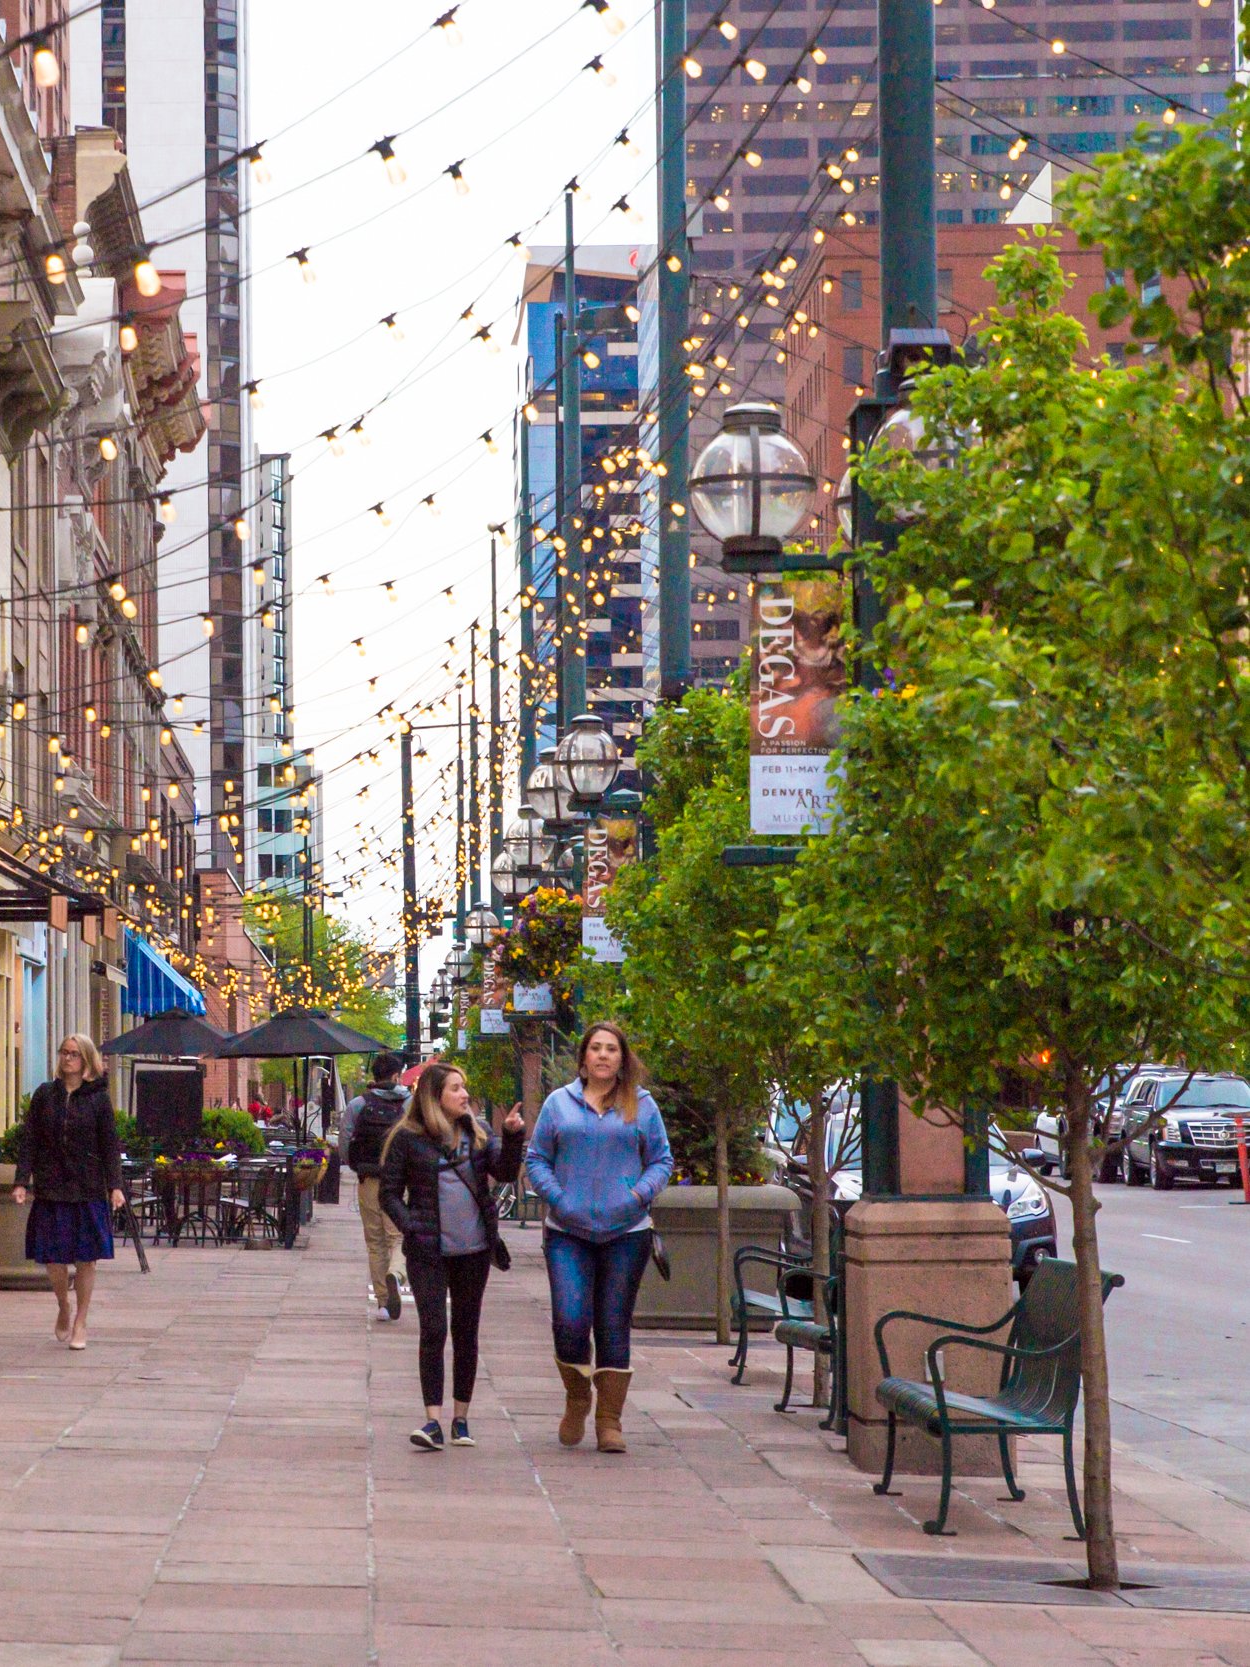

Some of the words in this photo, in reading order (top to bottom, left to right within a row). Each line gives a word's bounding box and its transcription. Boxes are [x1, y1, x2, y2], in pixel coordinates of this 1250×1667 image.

[758, 596, 795, 739] DEGAS
[760, 747, 778, 755] FOR
[762, 765, 782, 774] FEB
[762, 788, 813, 797] DENVER
[795, 793, 835, 809] ART
[483, 961, 496, 1005] DEGAS
